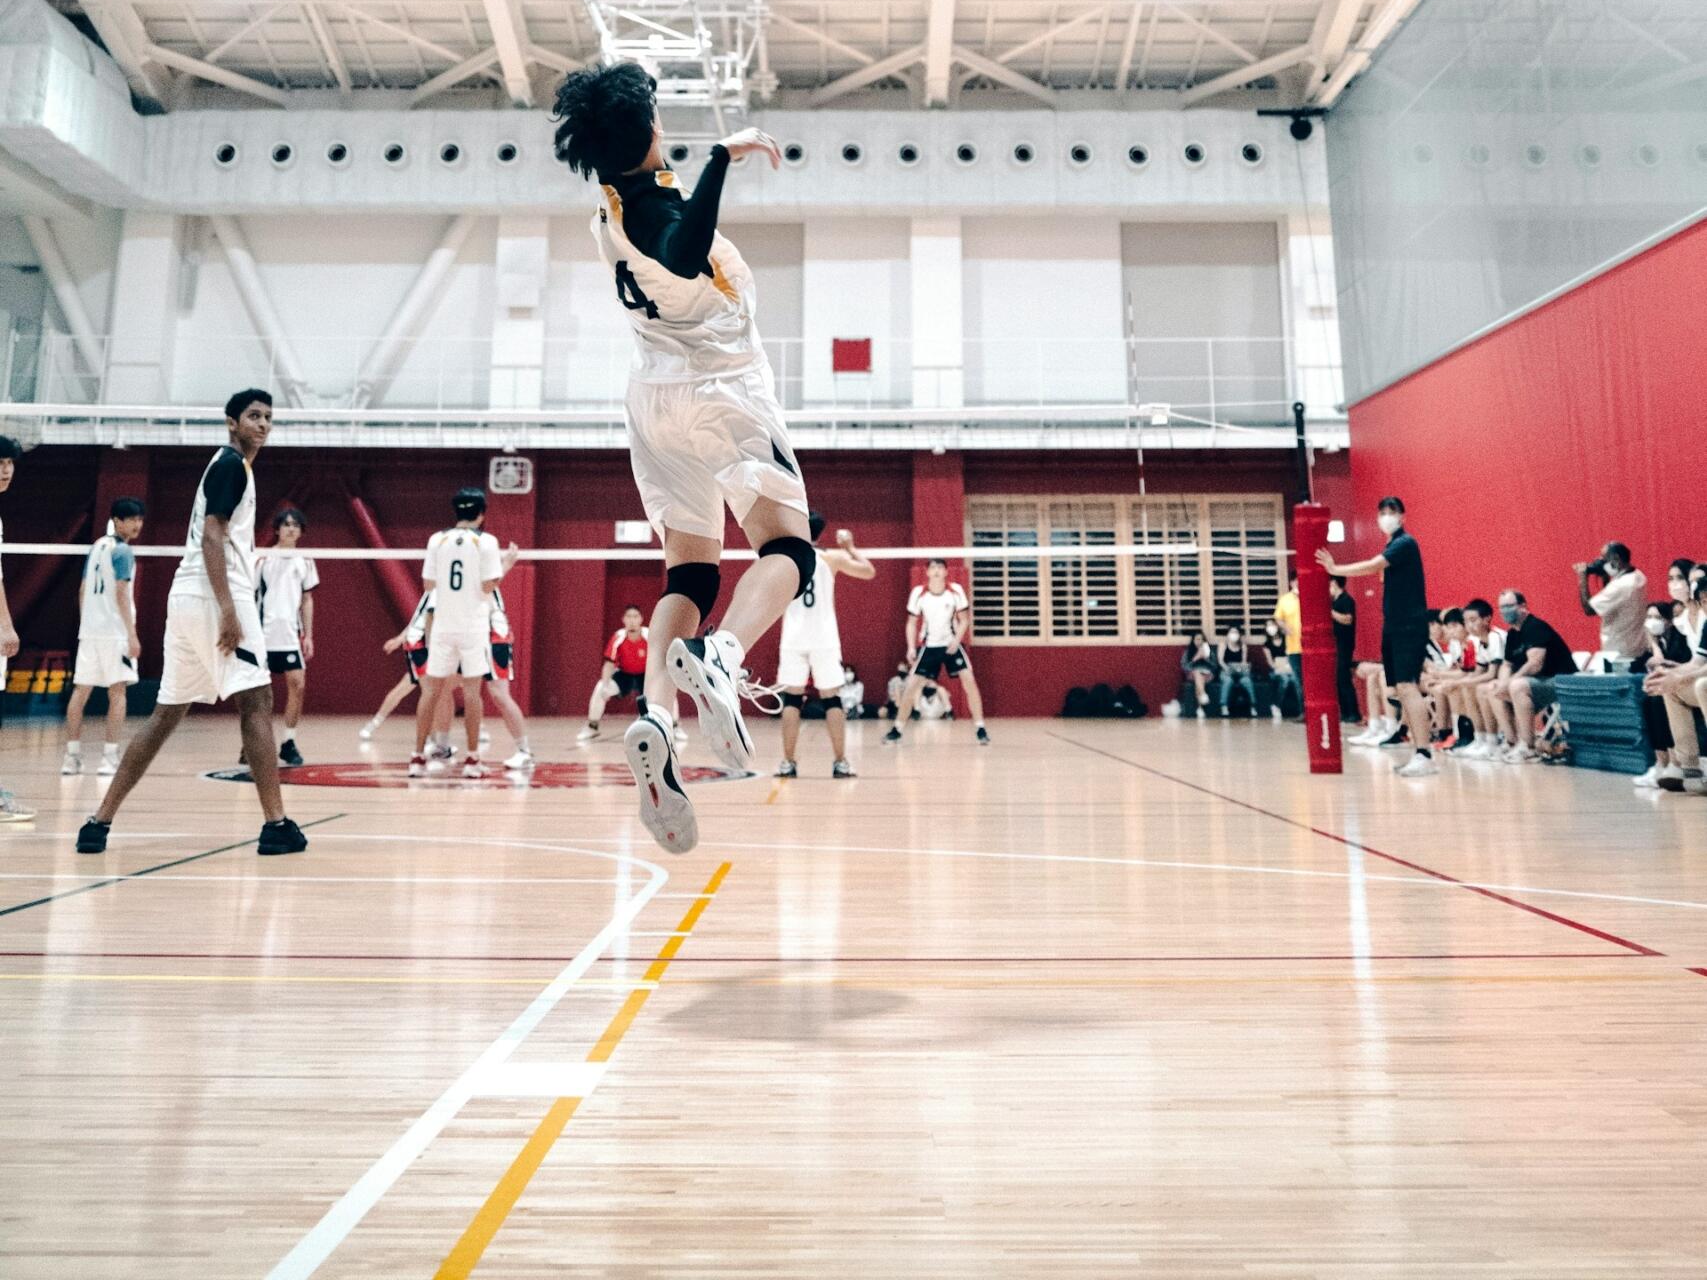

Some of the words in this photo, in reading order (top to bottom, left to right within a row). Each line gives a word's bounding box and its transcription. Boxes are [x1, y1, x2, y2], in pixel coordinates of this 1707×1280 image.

[615, 260, 661, 320] 4
[449, 559, 463, 591] 6
[803, 578, 815, 608] 8
